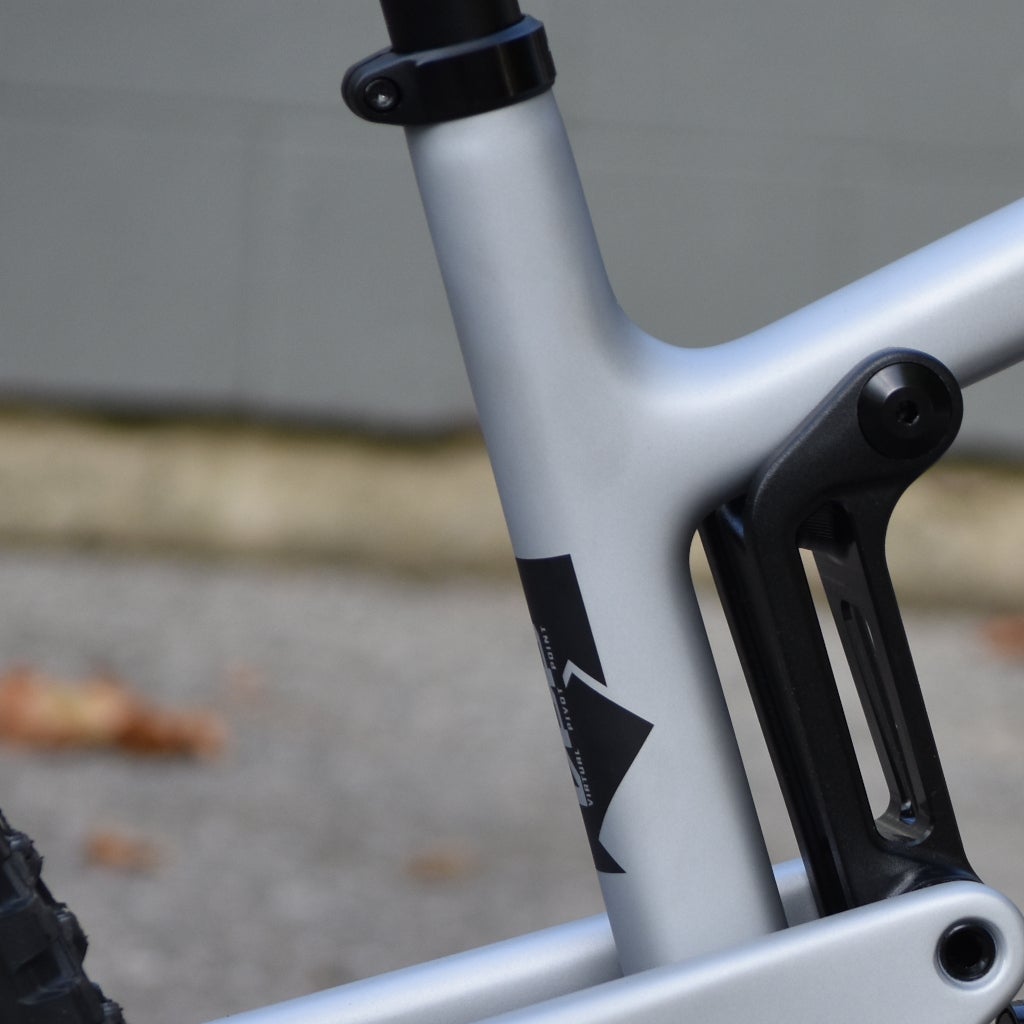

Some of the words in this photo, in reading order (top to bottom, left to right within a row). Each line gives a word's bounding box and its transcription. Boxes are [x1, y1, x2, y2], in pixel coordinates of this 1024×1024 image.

[539, 625, 557, 671] POINT
[557, 687, 574, 732] PIVOT
[574, 749, 594, 807] VIRTUAL
